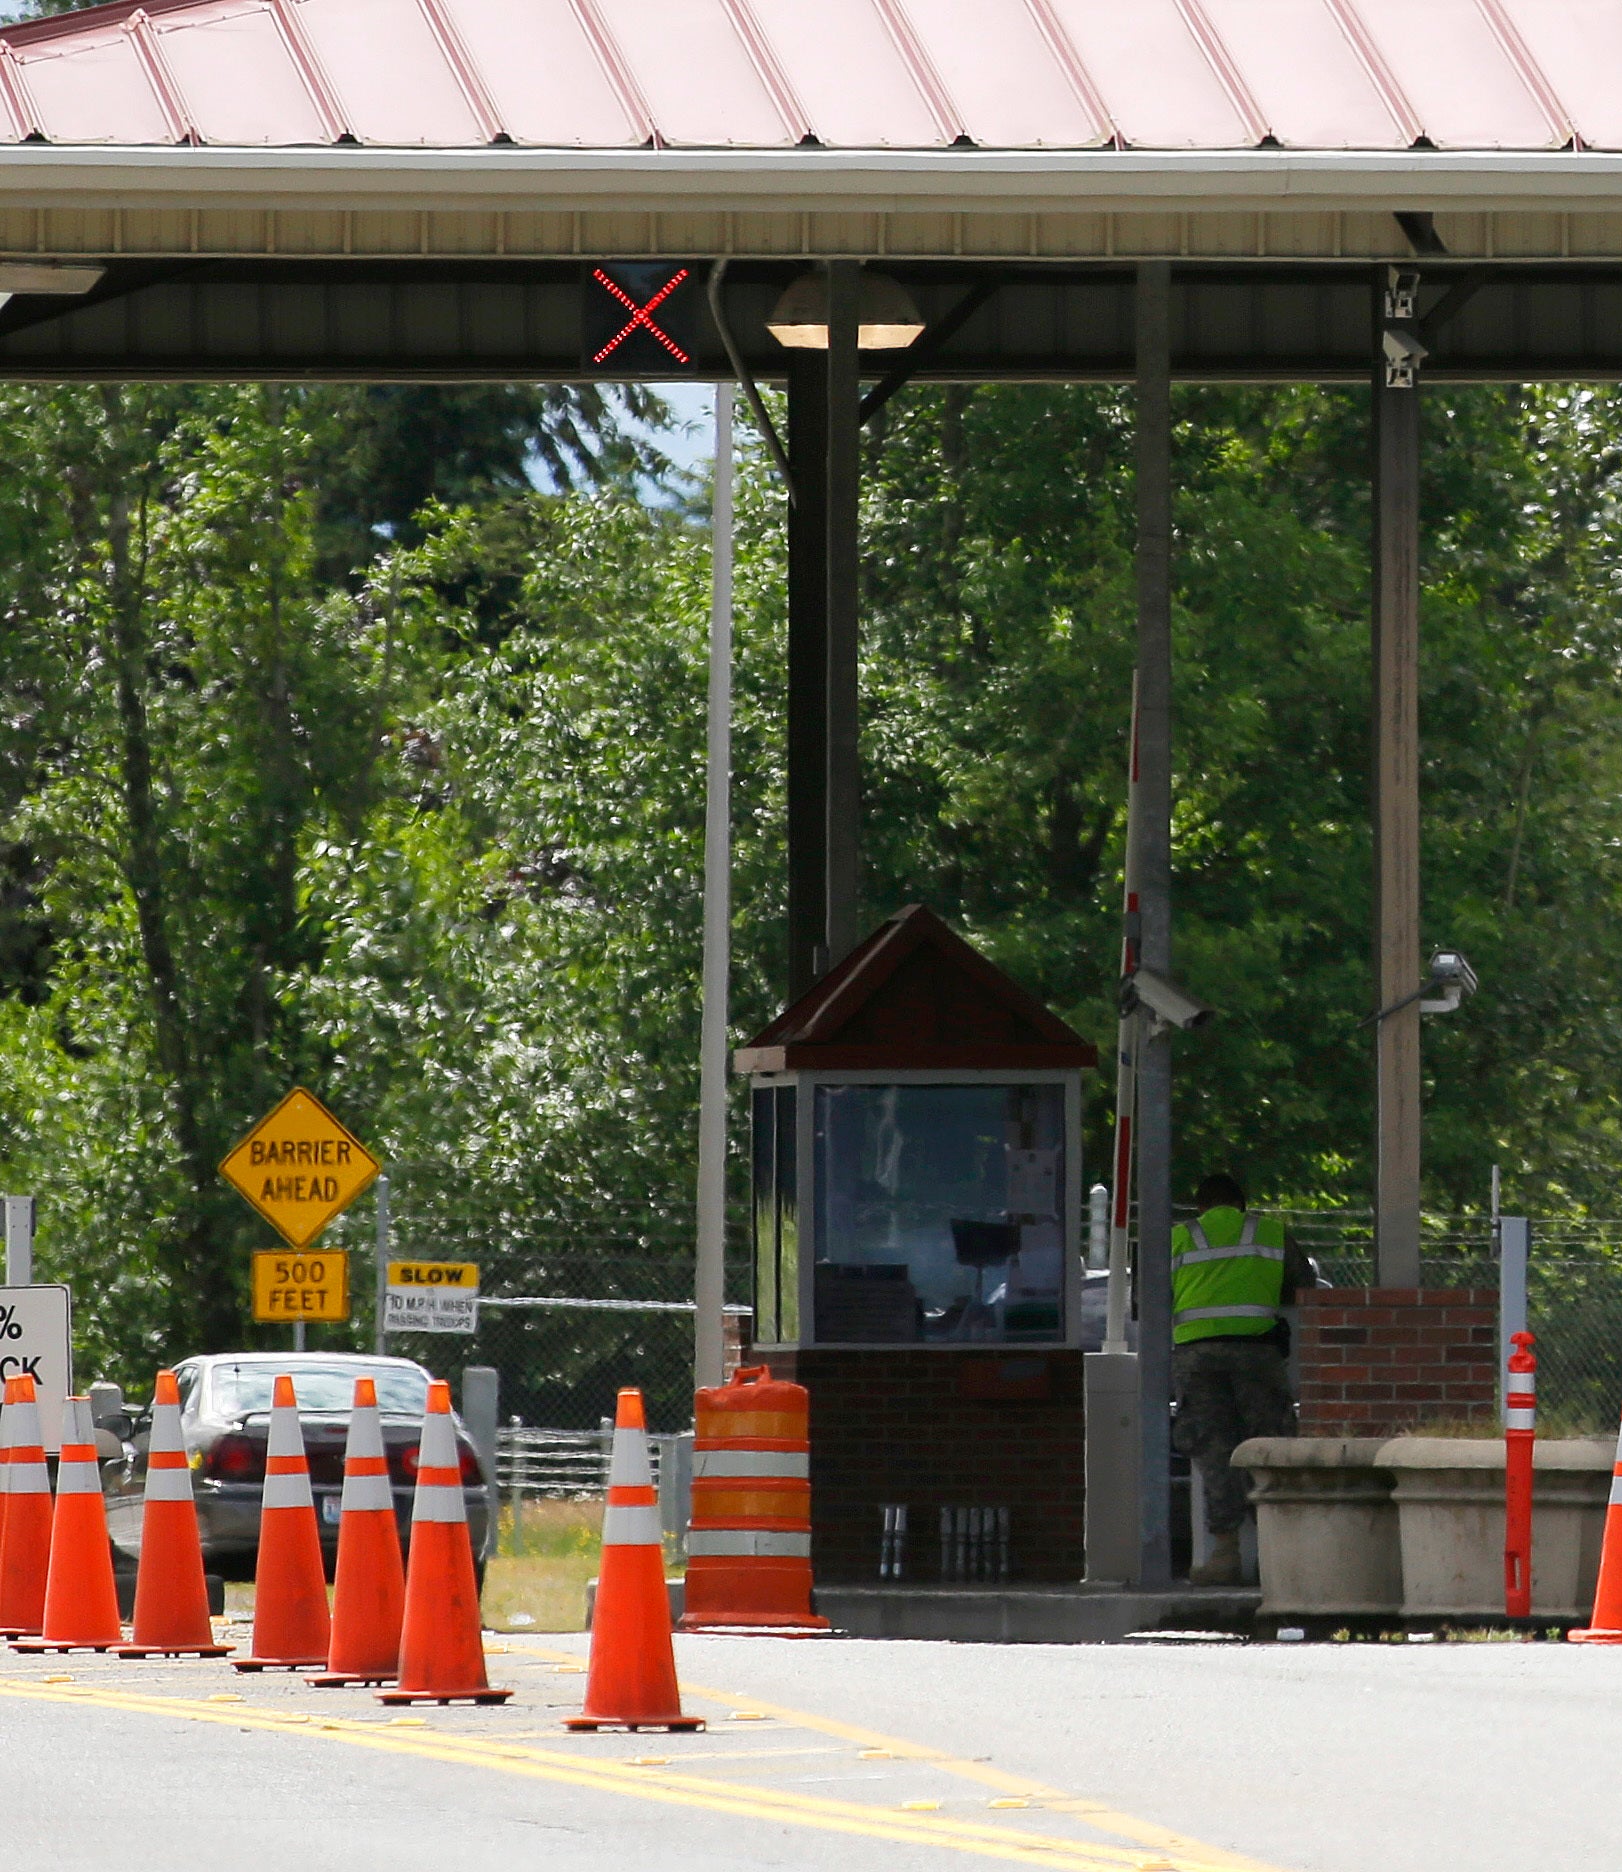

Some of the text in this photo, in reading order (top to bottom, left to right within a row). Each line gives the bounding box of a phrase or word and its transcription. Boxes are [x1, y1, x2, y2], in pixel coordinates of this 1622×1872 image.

[250, 1140, 351, 1166] BARRIER
[260, 1175, 338, 1202] AHEAD
[275, 1261, 325, 1283] 500
[400, 1266, 463, 1283] SLOW
[268, 1289, 328, 1311] FEET
[389, 1294, 403, 1310] 10
